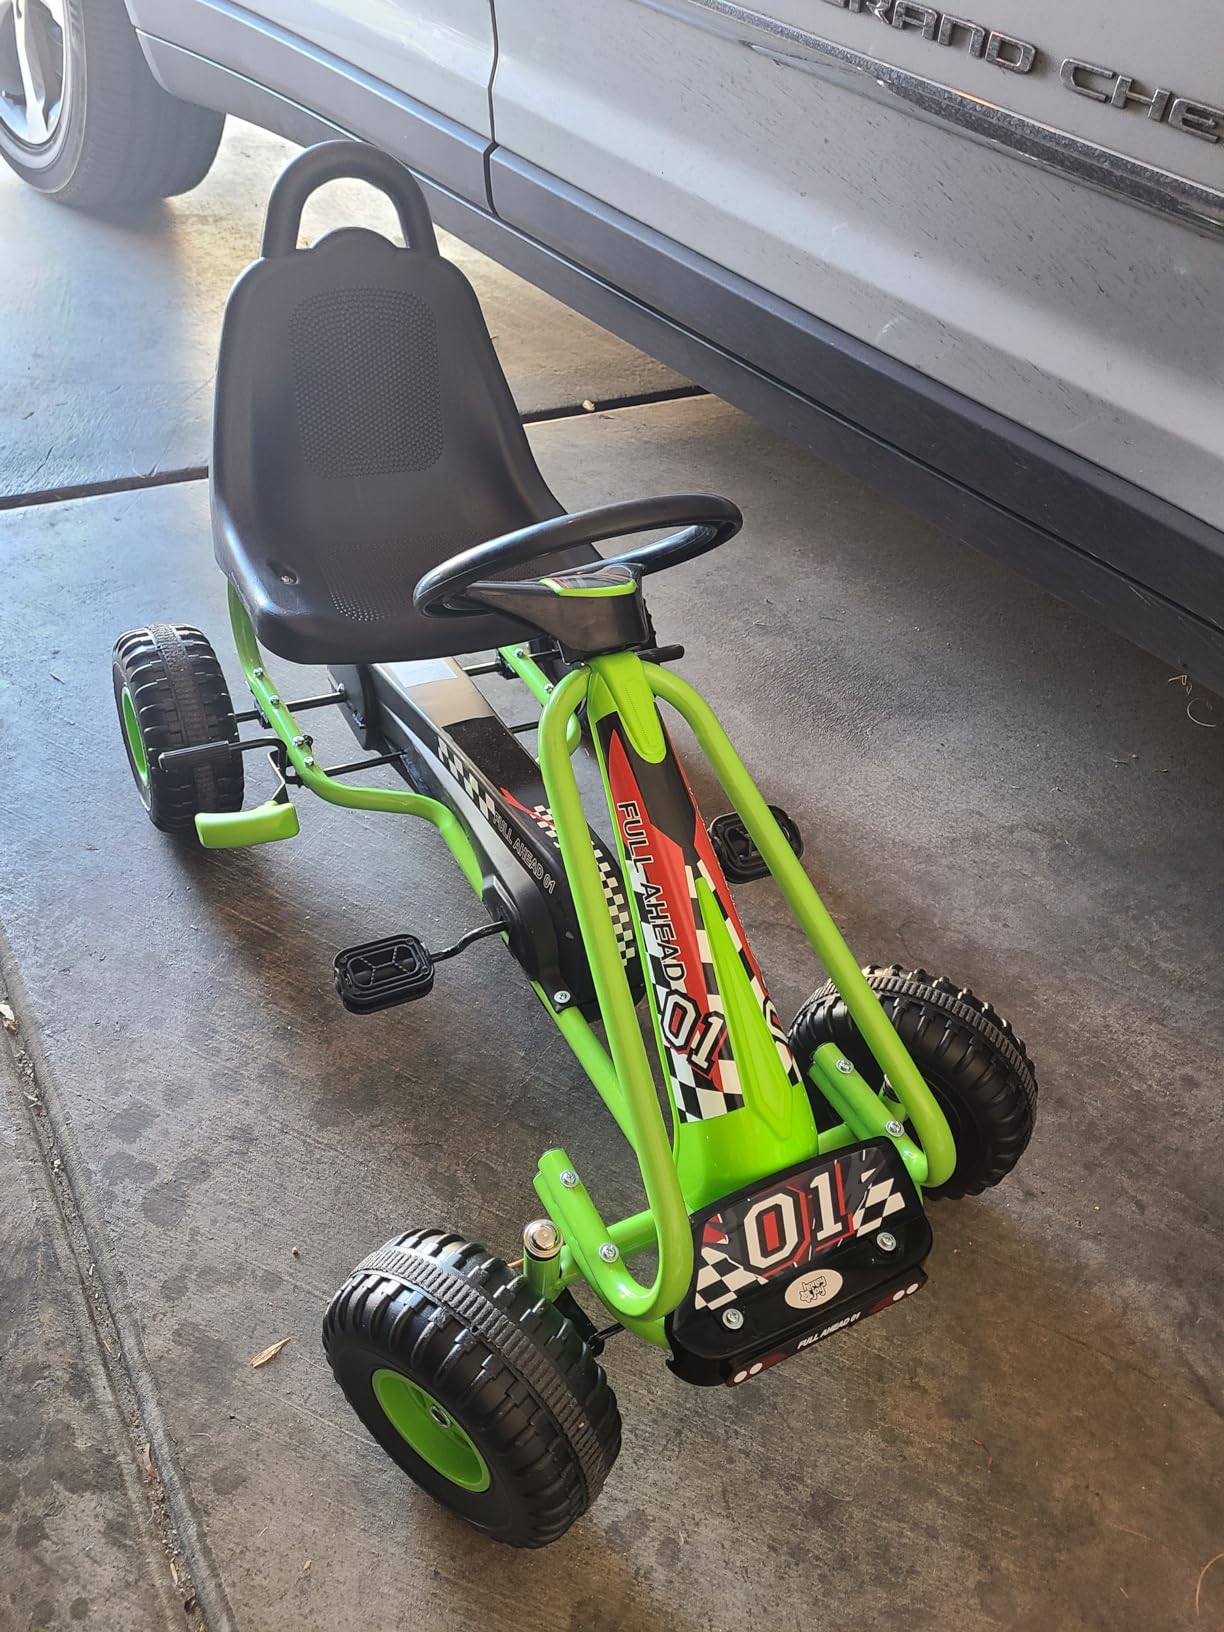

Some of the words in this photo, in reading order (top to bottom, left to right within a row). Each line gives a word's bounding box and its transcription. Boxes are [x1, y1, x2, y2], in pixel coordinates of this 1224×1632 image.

[493, 811, 513, 845] FULL
[512, 838, 544, 880] AHEAD
[543, 873, 556, 895] 01
[617, 800, 654, 873] FULL
[640, 882, 686, 982] AHEAD
[661, 990, 725, 1074] 01
[743, 1171, 842, 1269] 01
[797, 1333, 819, 1350] FULL
[819, 1317, 850, 1338] AHEAD
